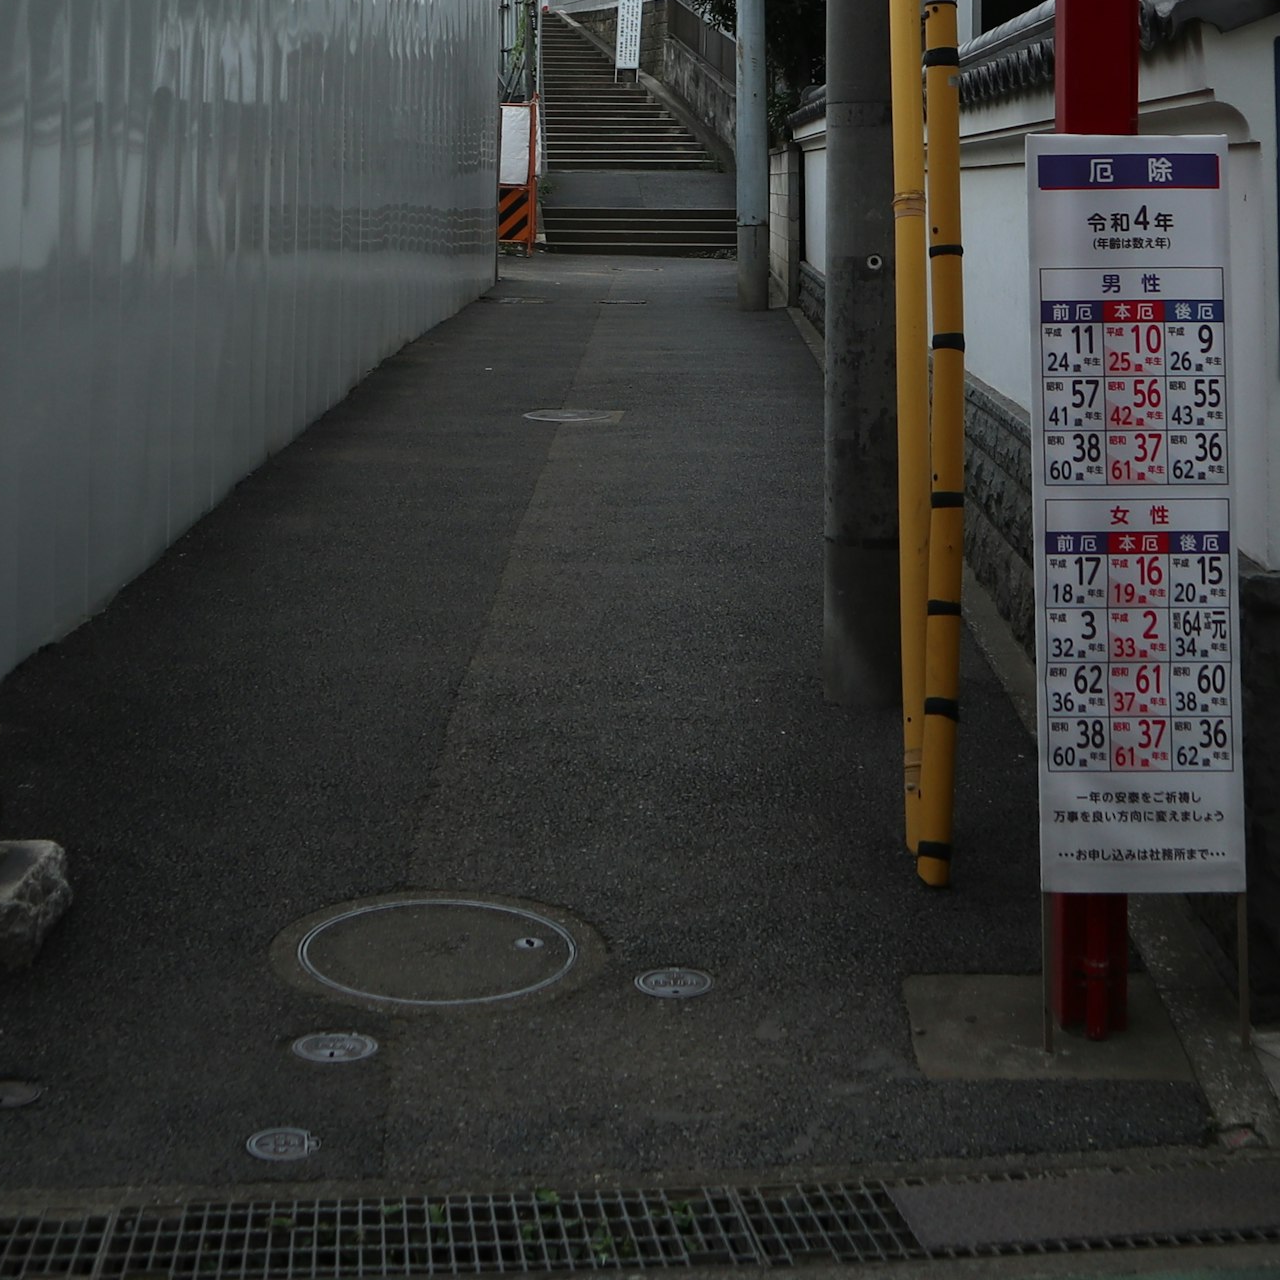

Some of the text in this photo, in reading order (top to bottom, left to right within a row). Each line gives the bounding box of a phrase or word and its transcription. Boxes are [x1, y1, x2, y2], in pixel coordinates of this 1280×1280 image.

[1087, 205, 1174, 233] 令和4年
[1102, 274, 1161, 294] 男性
[1052, 303, 1093, 320] 前厄
[1114, 303, 1154, 320] 本厄
[1174, 302, 1214, 320] 後厄
[1111, 506, 1170, 525] 女性
[1057, 535, 1098, 552] 前厄
[1118, 534, 1159, 552] 本厄
[1180, 534, 1220, 551] 後厄
